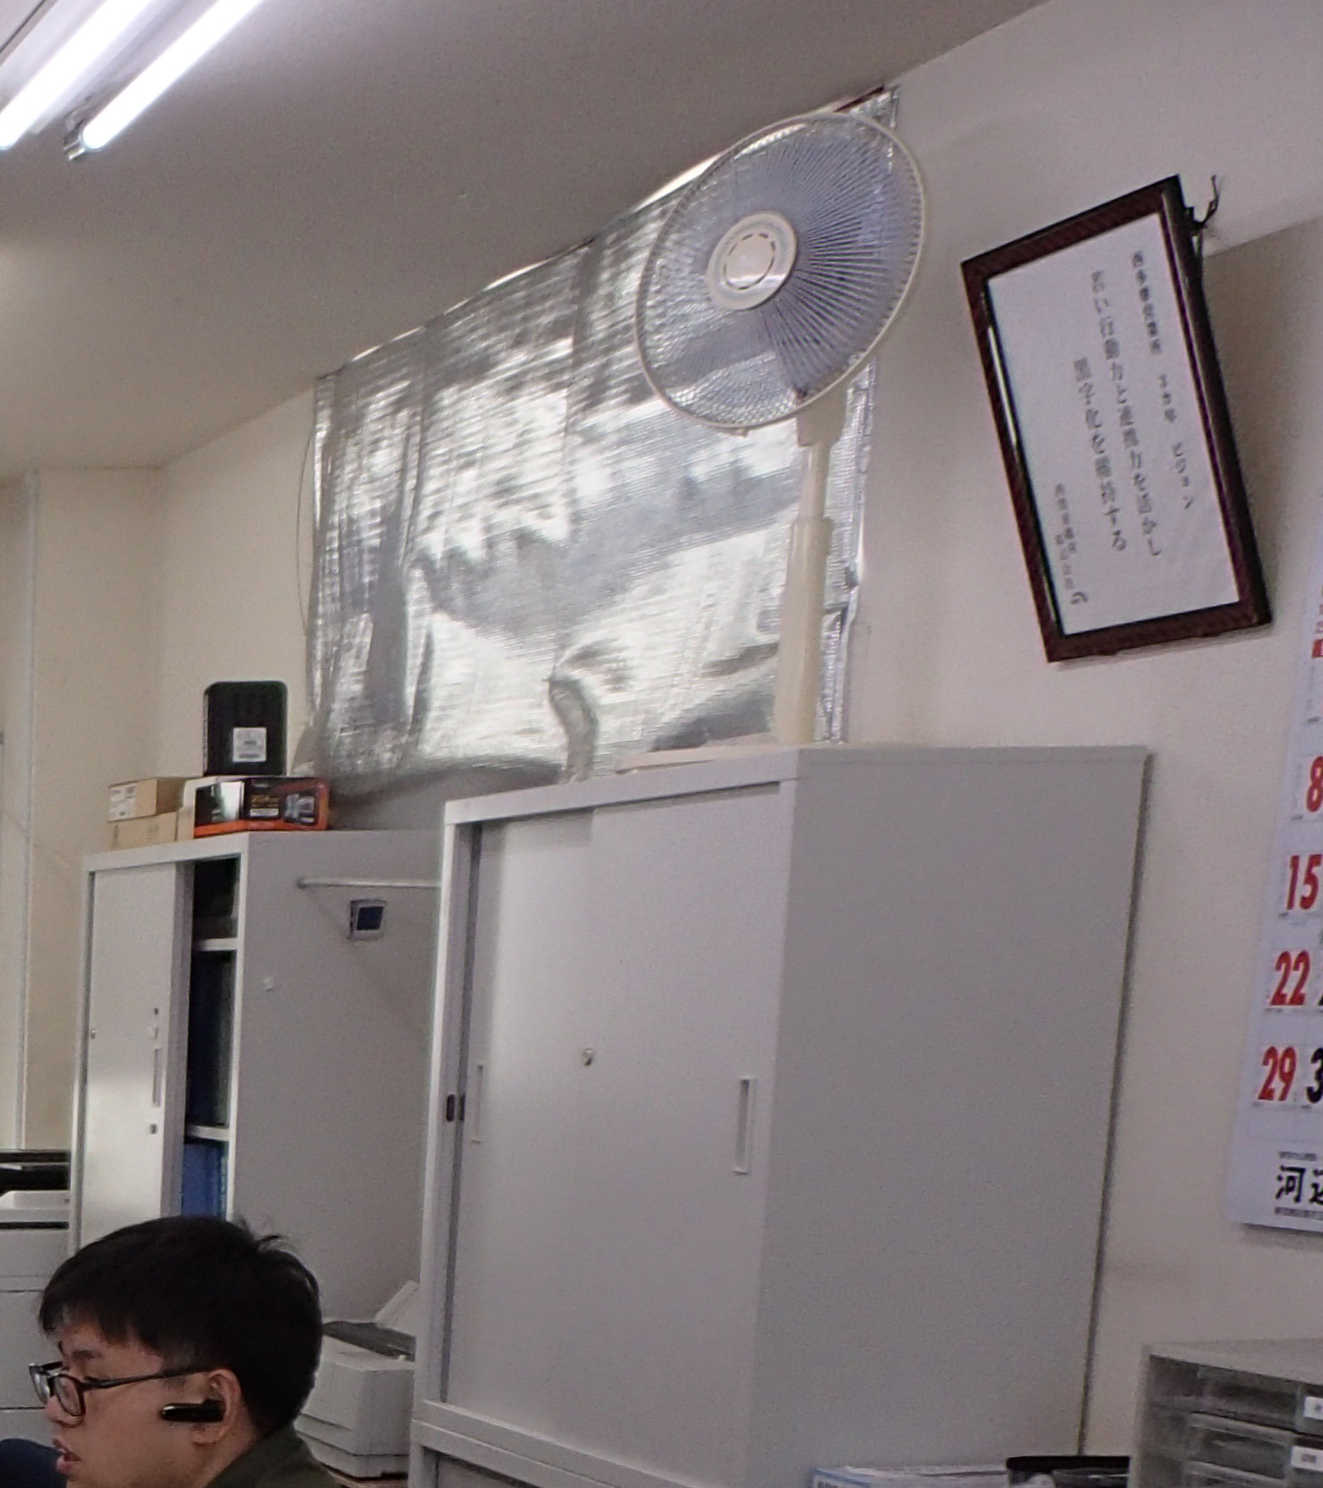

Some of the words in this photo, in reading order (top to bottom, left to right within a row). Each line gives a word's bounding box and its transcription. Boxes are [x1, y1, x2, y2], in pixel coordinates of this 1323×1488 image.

[1306, 756, 1323, 813] 8
[1286, 854, 1323, 910] 15
[1269, 950, 1311, 1007] 22
[1257, 1046, 1298, 1102] 29
